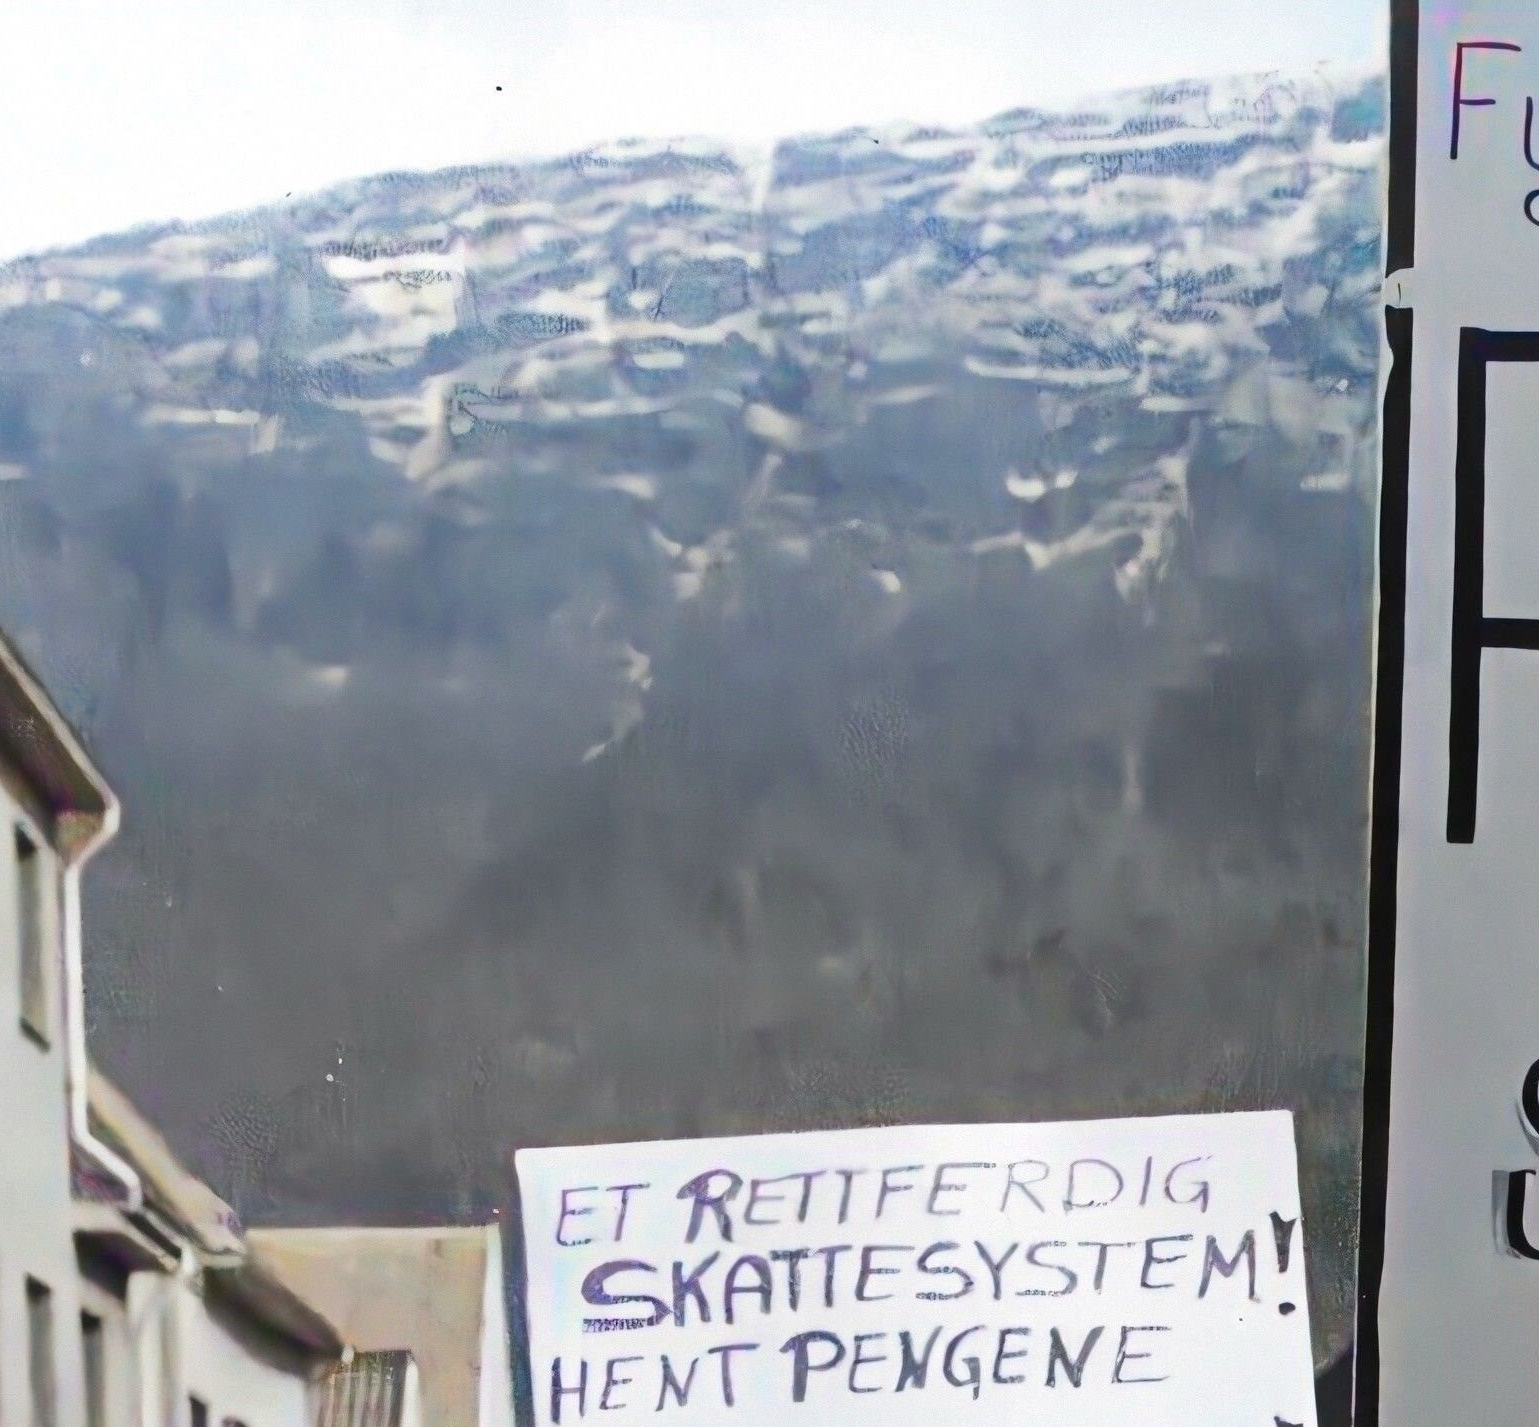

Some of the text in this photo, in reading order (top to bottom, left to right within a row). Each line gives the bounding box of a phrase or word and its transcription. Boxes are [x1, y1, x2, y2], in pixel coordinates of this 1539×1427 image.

[555, 1154, 1214, 1247] ET RETTFERDIG
[580, 1209, 1307, 1334] SKATTESYSTEM!
[550, 1324, 1174, 1425] HENT PENGENE
